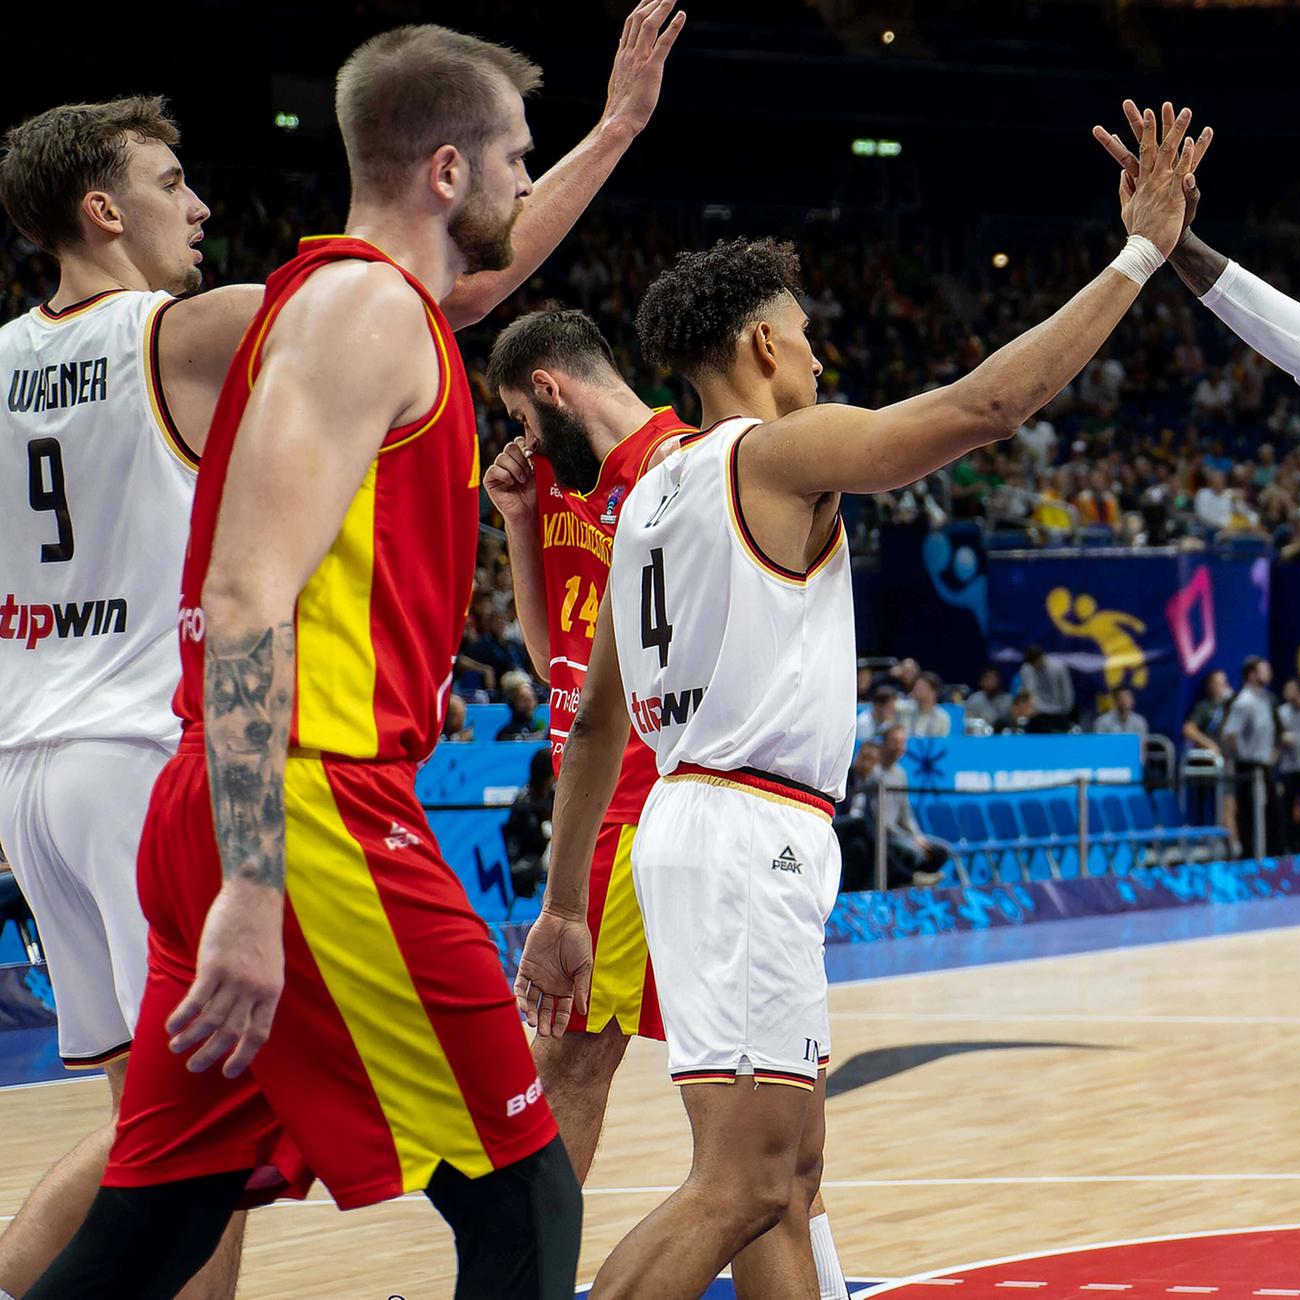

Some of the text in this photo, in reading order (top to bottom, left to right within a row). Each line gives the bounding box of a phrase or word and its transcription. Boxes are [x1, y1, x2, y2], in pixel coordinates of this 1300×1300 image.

[8, 357, 107, 412] WAGNER
[27, 437, 74, 563] 9
[0, 594, 127, 649] tipwin
[561, 575, 599, 639] 14
[641, 547, 673, 668] 4
[772, 859, 803, 875] PEAK
